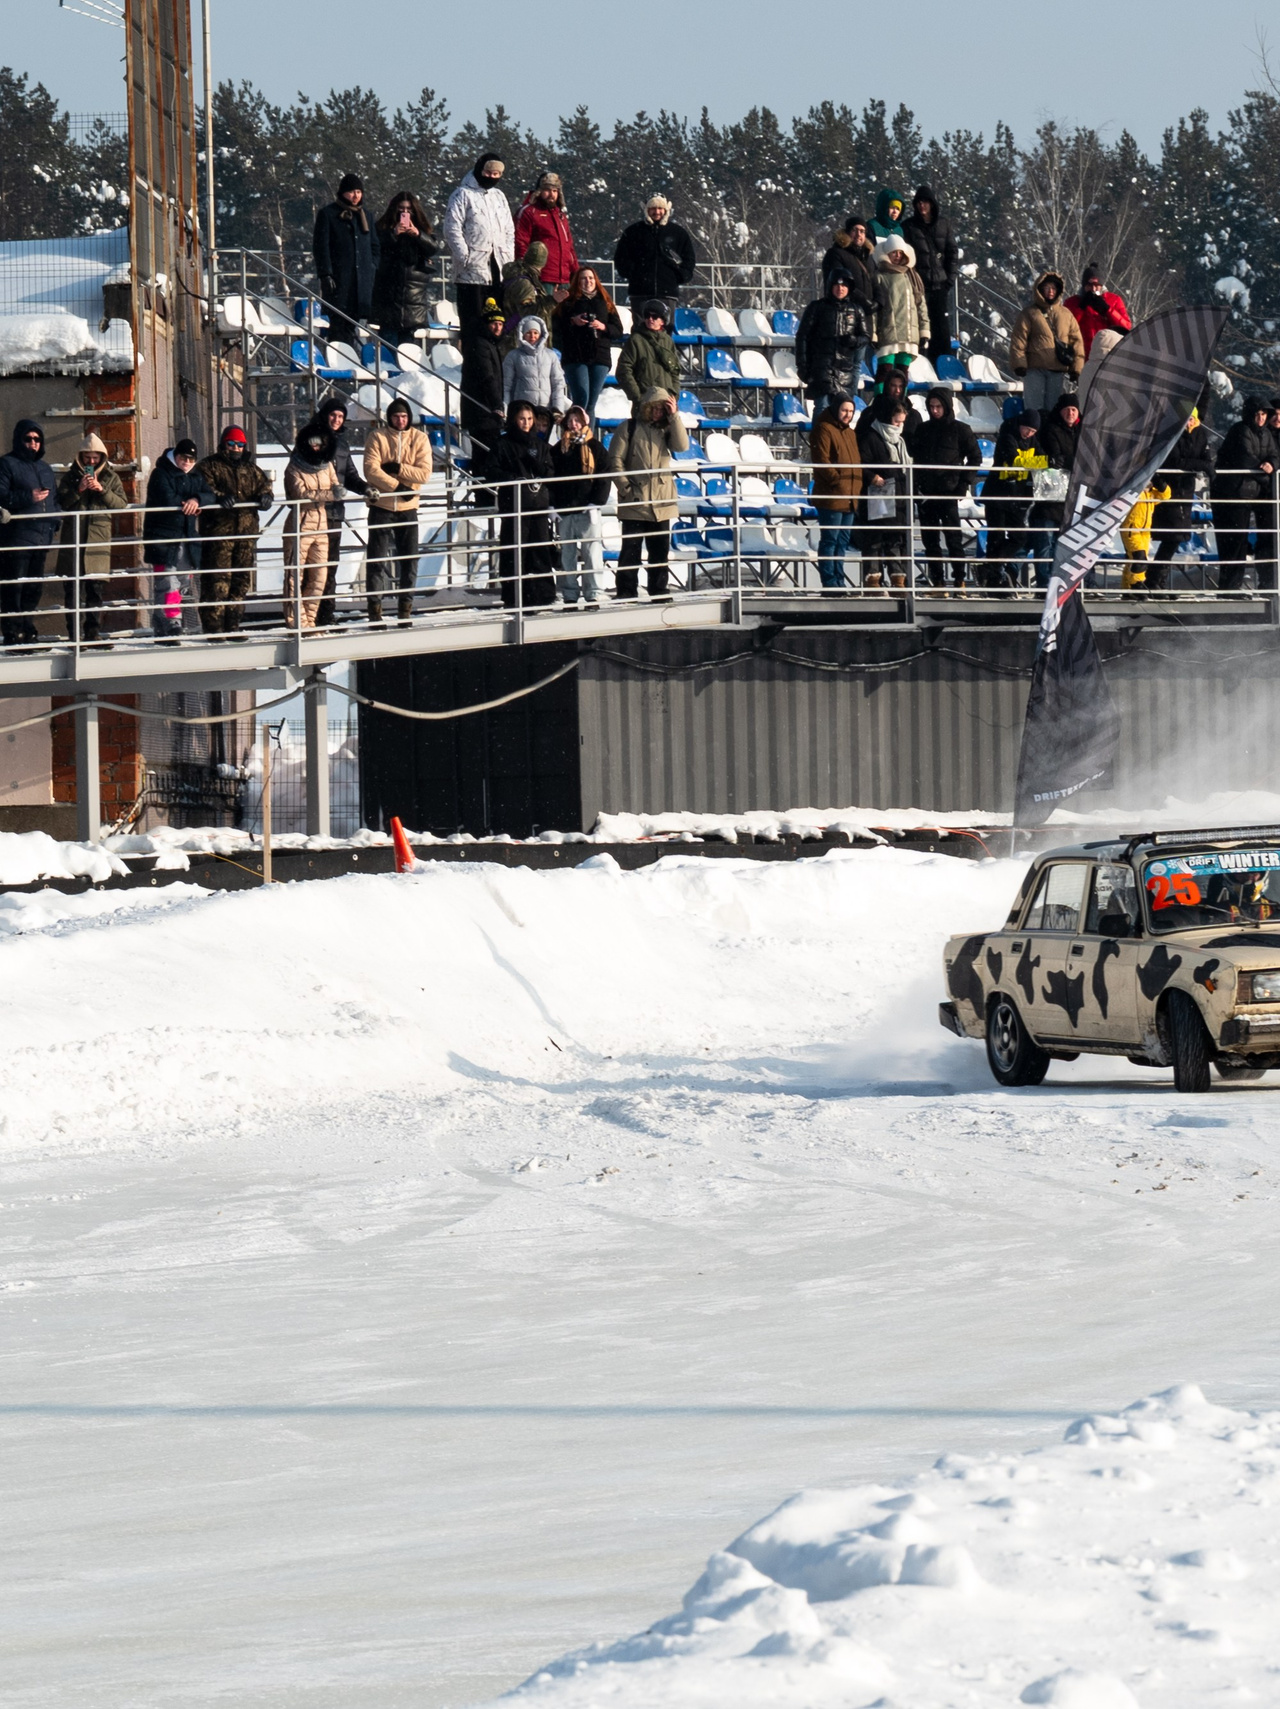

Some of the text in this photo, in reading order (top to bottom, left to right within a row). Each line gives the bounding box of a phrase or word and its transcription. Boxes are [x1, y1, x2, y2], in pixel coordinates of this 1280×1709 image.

[1189, 857, 1216, 867] DRIFT
[1218, 853, 1280, 869] WINTER
[1146, 873, 1202, 911] 25
